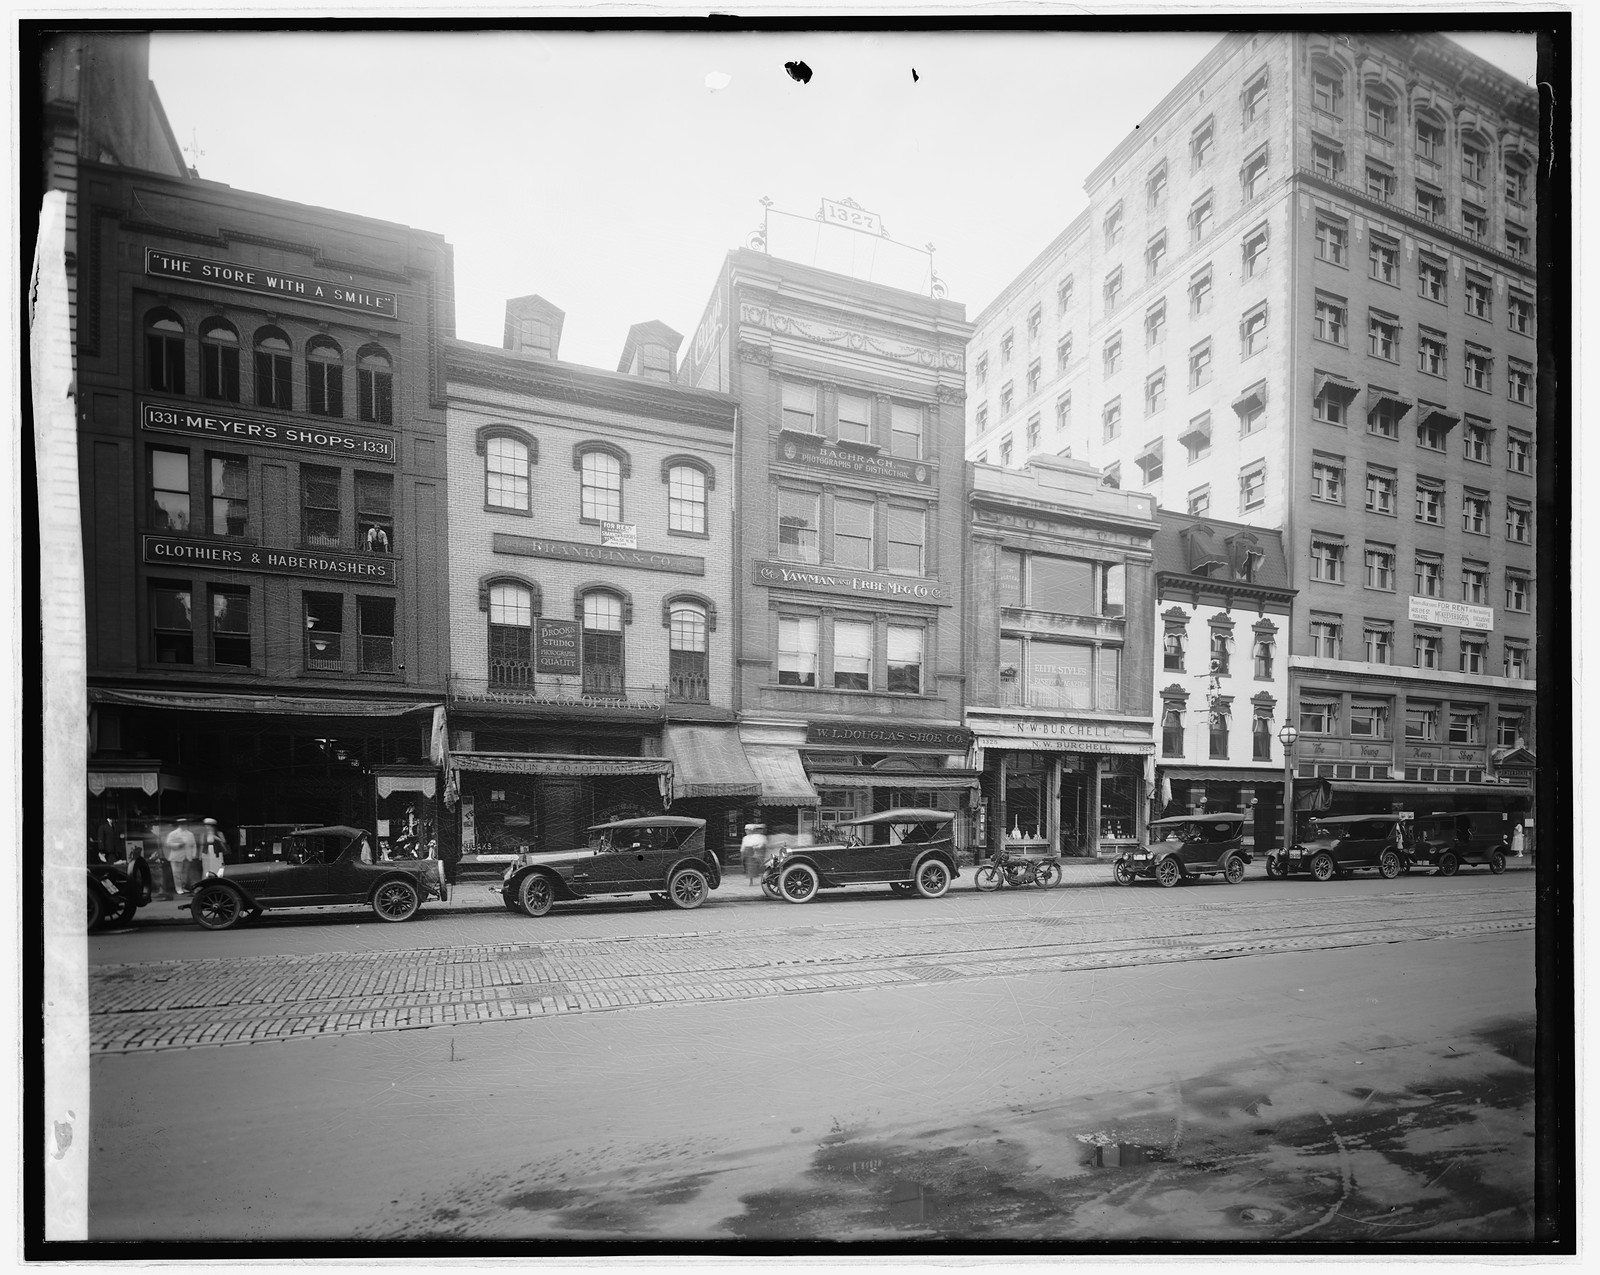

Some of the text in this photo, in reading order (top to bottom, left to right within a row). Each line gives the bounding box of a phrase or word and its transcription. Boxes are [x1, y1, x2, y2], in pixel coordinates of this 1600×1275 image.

[828, 204, 874, 229] 1327
[202, 264, 255, 285] STORE
[266, 276, 305, 294] WITH
[315, 286, 324, 297] A
[286, 430, 355, 450] SHOPS
[802, 454, 852, 468] PHOTOGRAPHS
[854, 463, 863, 472] OF
[603, 522, 615, 530] FOR
[532, 541, 629, 561] FRANKLIN
[632, 553, 641, 563] &
[155, 544, 386, 576] CLOTHIERS & HABERDASHERS
[780, 568, 835, 586] YAWMAN
[852, 577, 885, 591] ERBE
[1438, 602, 1450, 610] FOR
[1452, 604, 1469, 612] RENT
[541, 626, 576, 637] BROOKS
[543, 639, 575, 648] STUDIO
[540, 658, 576, 667] QUALITY
[1058, 666, 1088, 675] STYLES
[453, 691, 538, 704] FRANKLIN
[541, 694, 551, 706] &
[582, 695, 661, 711] OPTICIANS
[909, 732, 942, 743] SHOE
[1057, 741, 1110, 750] BURCHELL
[1360, 745, 1380, 758] Young
[488, 762, 538, 770] FRANKLIN
